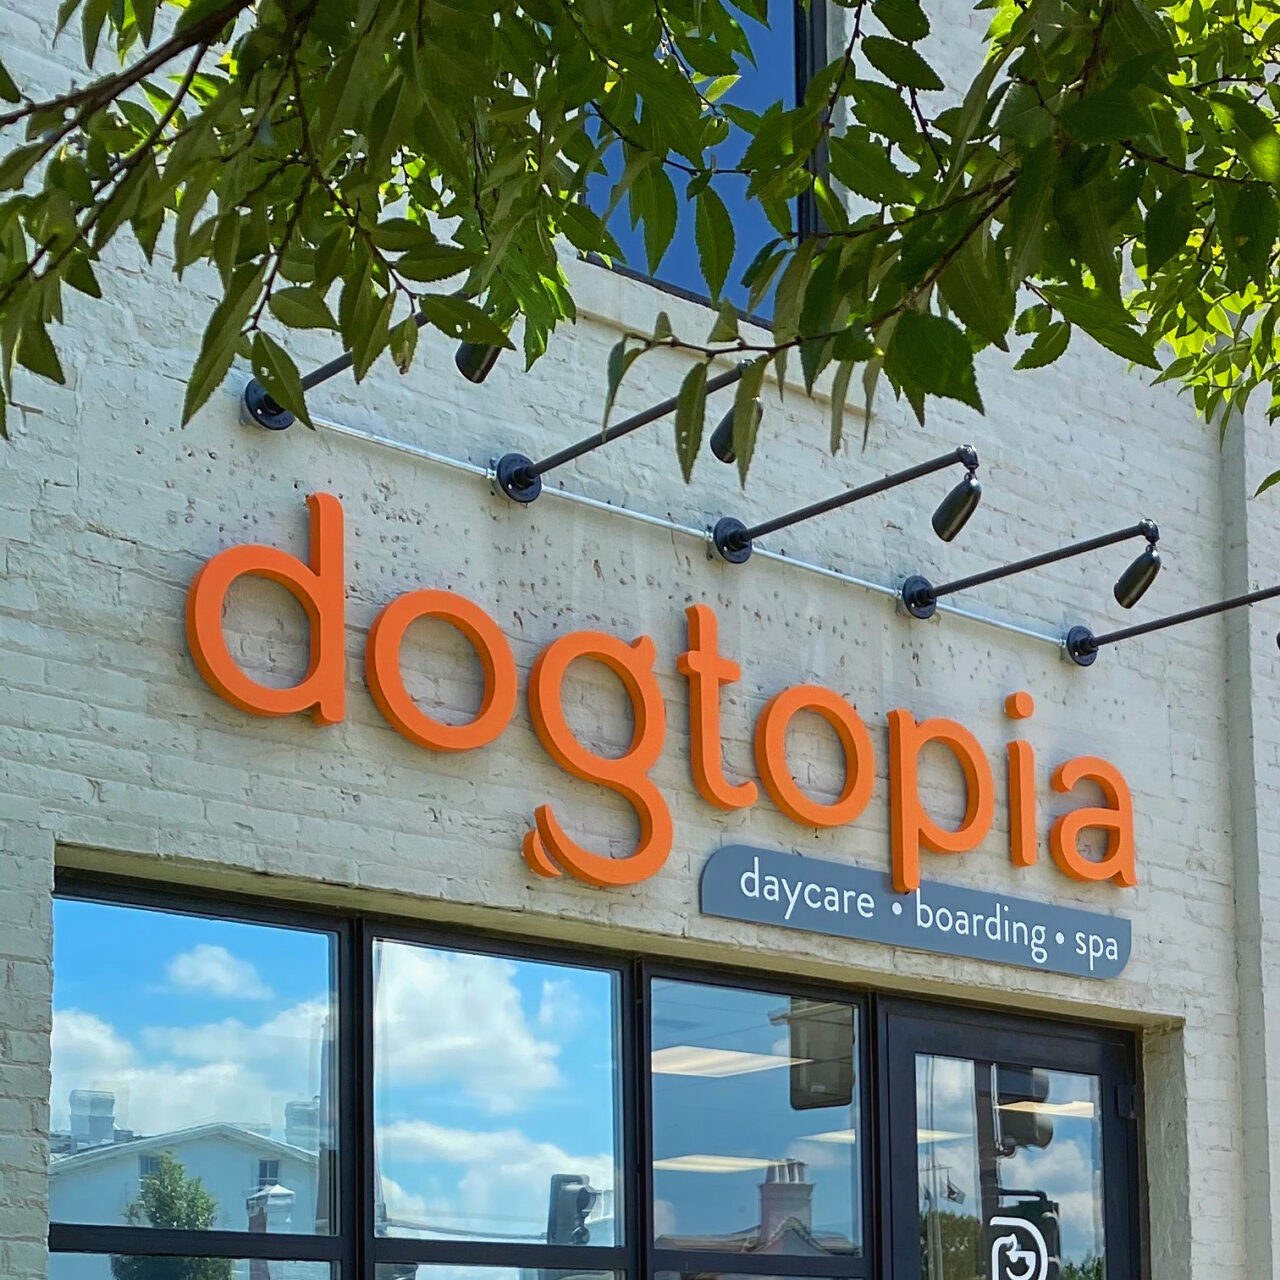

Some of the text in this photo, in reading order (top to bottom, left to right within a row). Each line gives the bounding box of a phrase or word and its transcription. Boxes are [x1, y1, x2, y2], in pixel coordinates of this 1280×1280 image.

[186, 492, 1137, 892] dogtopia
[740, 857, 1118, 970] daycare boarding spa
